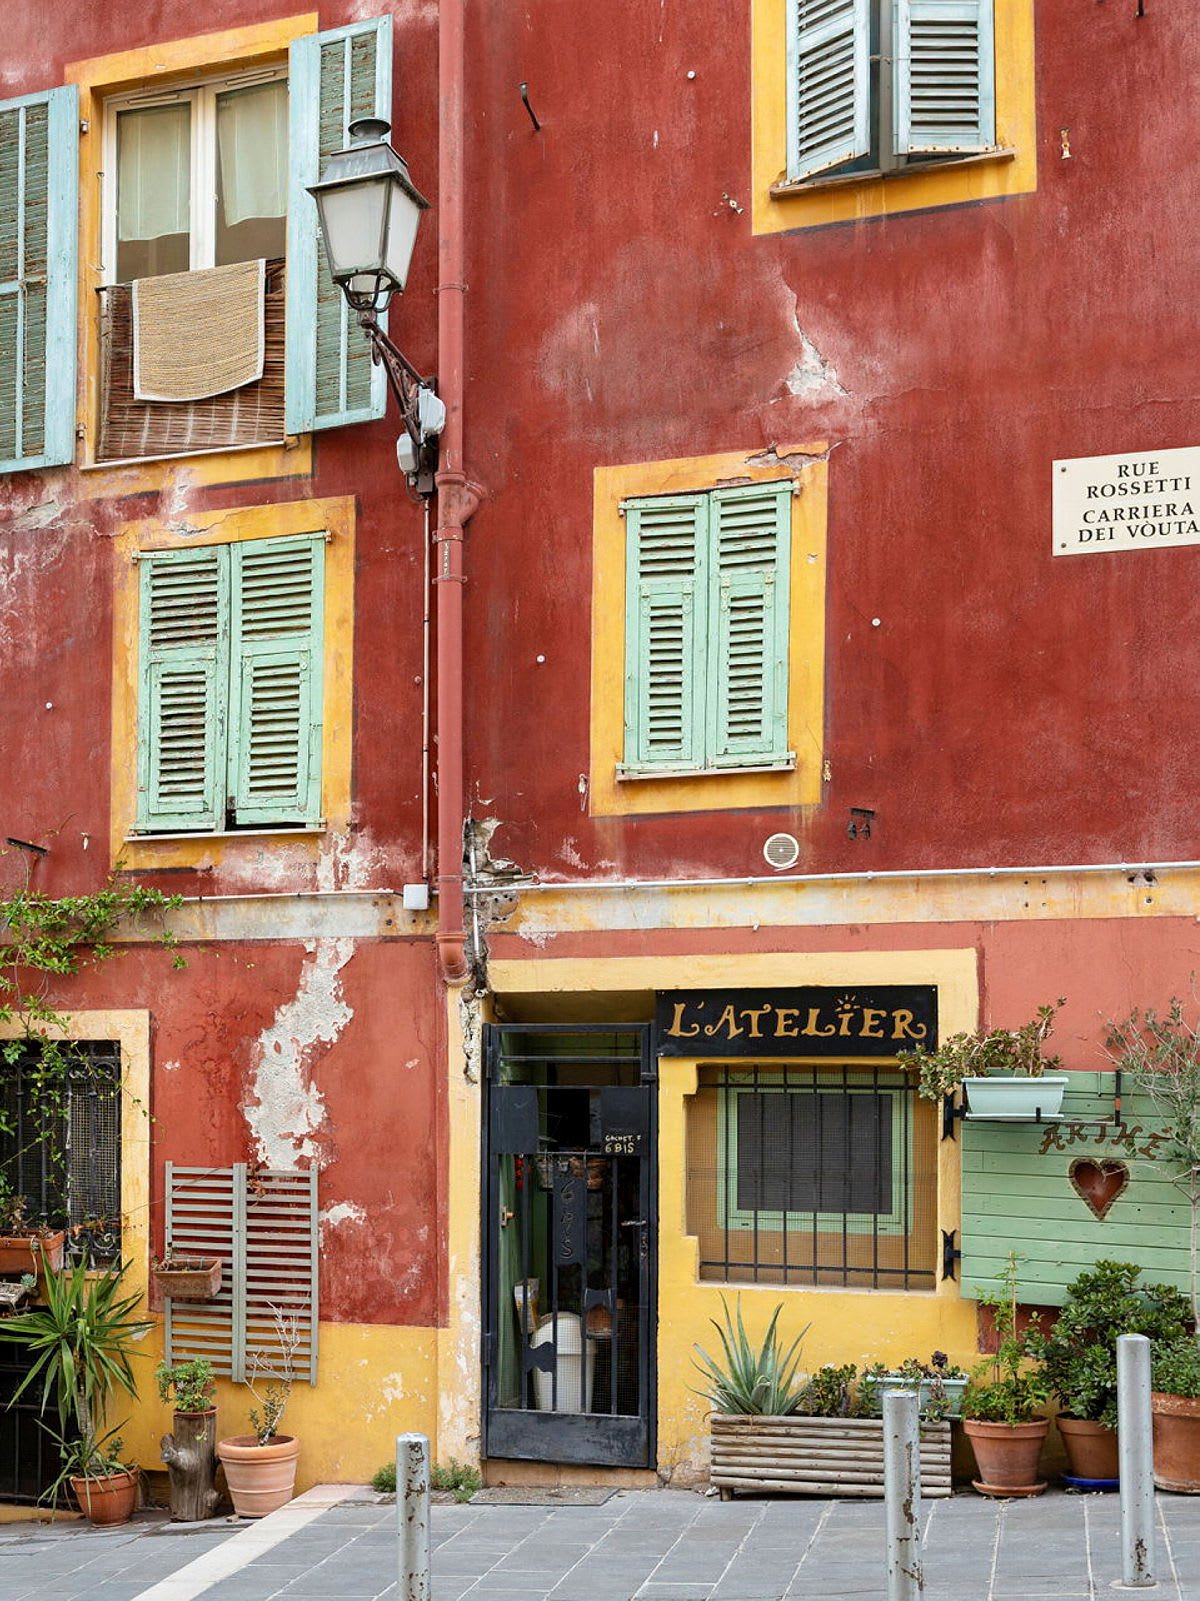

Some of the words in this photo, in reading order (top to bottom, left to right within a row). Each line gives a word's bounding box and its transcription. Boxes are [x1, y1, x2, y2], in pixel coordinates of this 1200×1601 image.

[1117, 461, 1160, 478] RUE
[1086, 476, 1192, 499] ROSSETTI
[1082, 502, 1195, 524] CARRIERA
[1078, 527, 1115, 543] DEI
[1126, 520, 1200, 538] VÒUTA
[667, 995, 927, 1040] L'ATELIER
